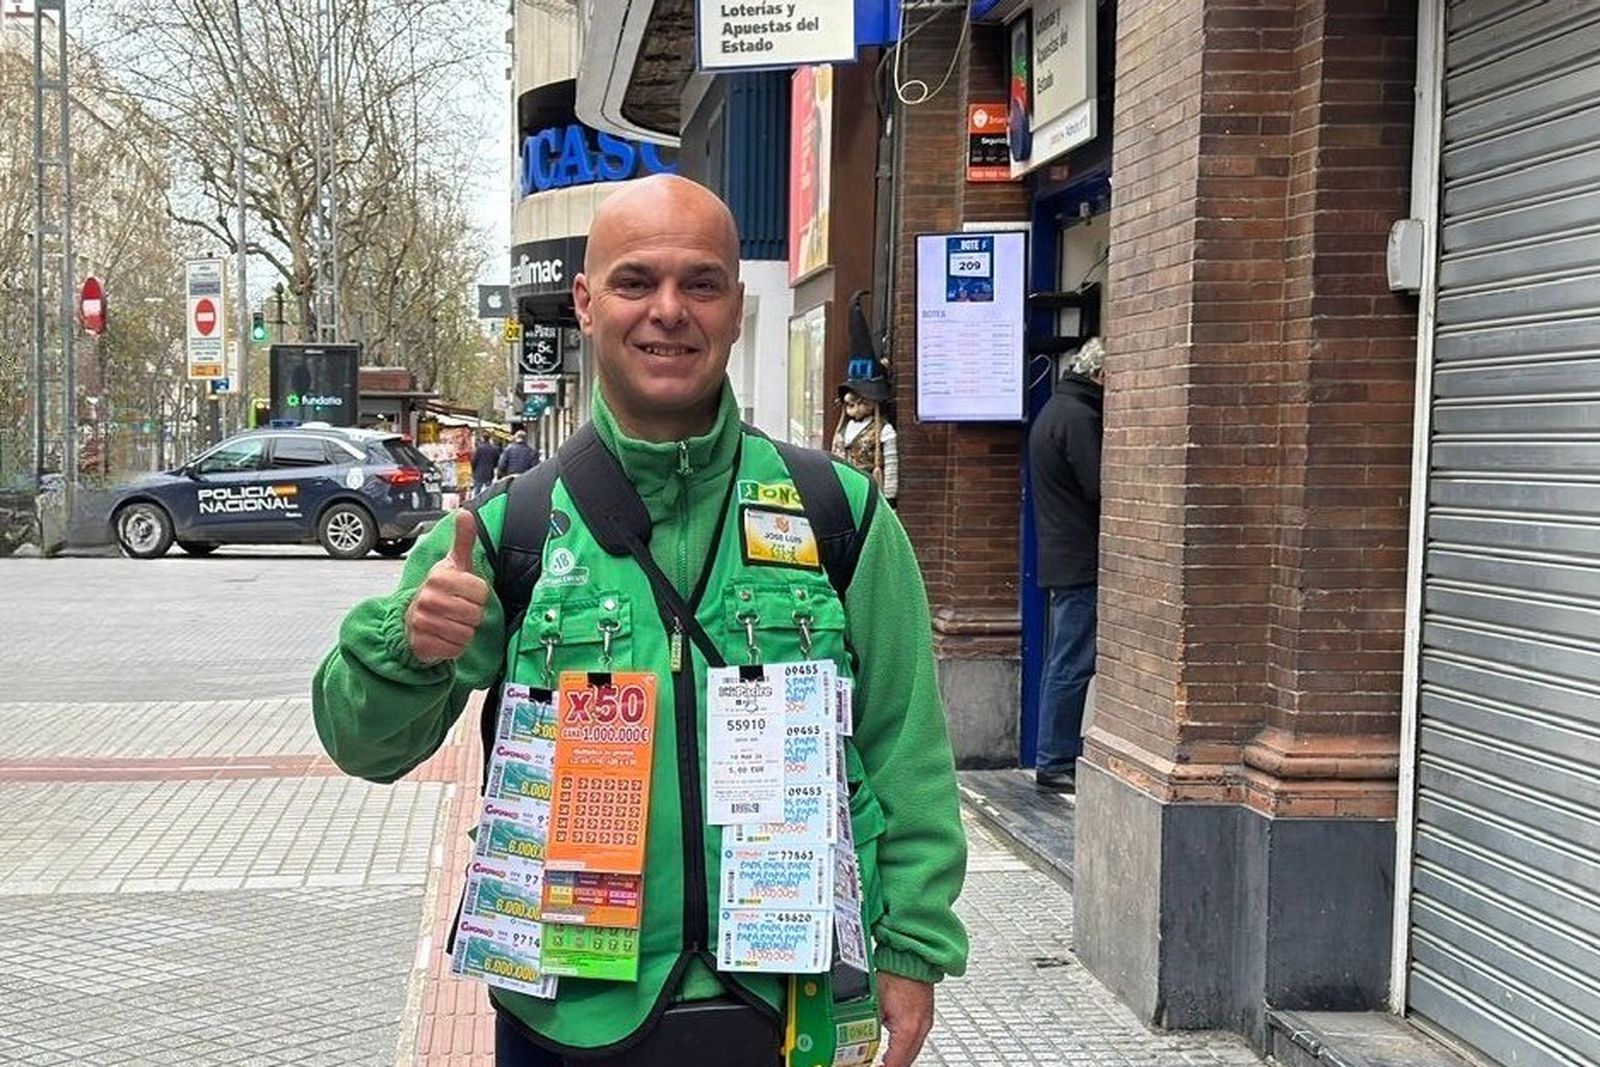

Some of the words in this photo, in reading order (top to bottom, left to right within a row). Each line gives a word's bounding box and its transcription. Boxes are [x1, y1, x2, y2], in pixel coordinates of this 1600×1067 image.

[721, 1, 783, 18] Loterías
[786, 3, 796, 17] y
[722, 20, 792, 37] Apuestas
[796, 16, 819, 32] del
[721, 38, 773, 54] Estado
[961, 239, 979, 251] BOTE
[958, 260, 981, 271] 209
[198, 484, 277, 501] POLICIA
[762, 487, 801, 504] ONC
[199, 496, 299, 514] NACIONAL
[726, 718, 767, 731] 55910
